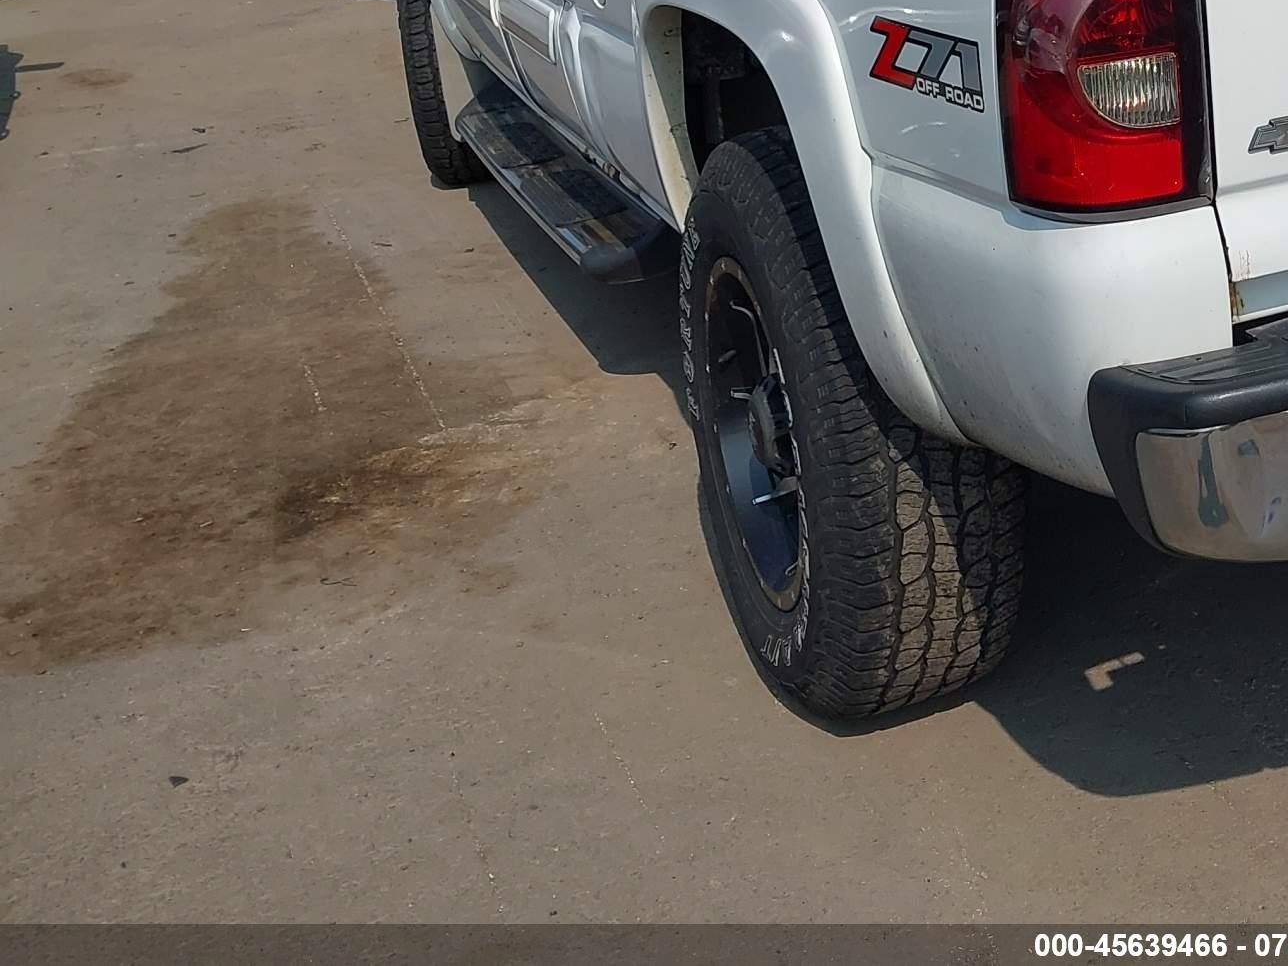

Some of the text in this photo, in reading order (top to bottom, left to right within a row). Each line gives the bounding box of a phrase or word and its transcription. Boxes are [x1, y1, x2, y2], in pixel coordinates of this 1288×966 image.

[869, 15, 984, 94] Z71
[916, 77, 985, 111] OFF ROAD
